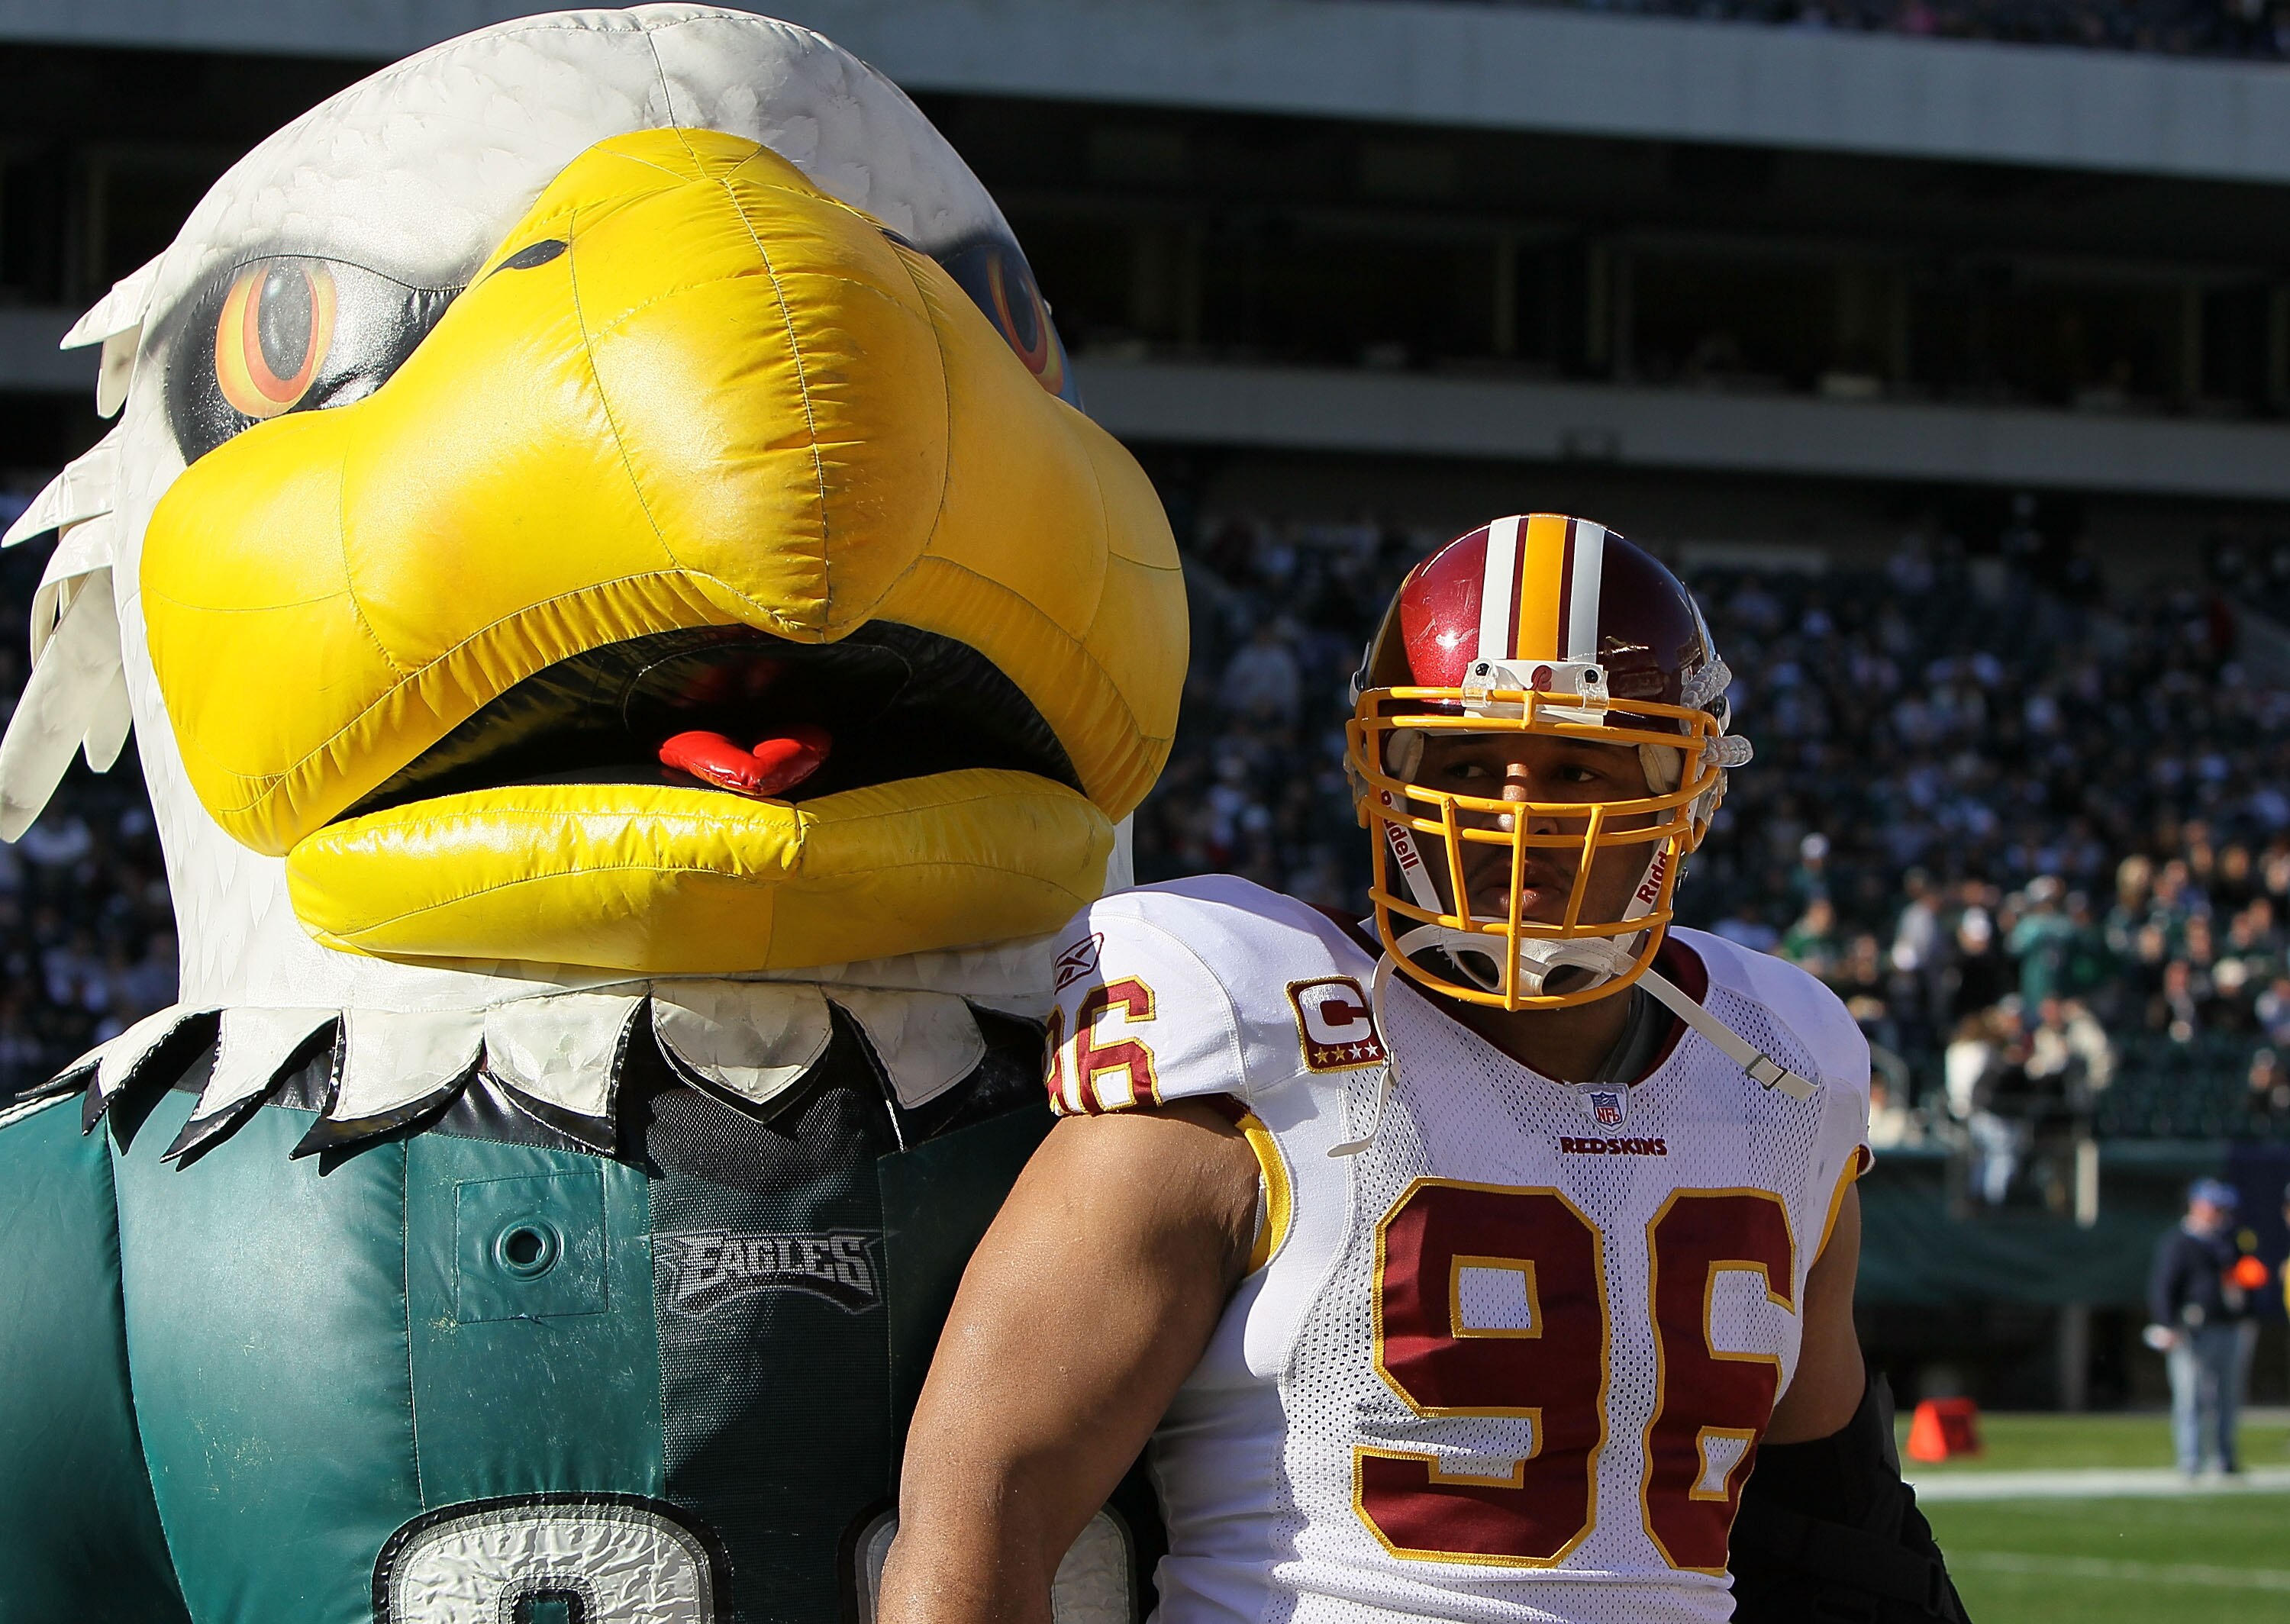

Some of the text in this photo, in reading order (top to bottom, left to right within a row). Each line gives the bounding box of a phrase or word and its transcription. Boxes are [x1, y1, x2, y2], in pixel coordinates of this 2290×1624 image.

[1381, 790, 1420, 871] Rdell
[1637, 842, 1669, 905] Ridd
[1298, 983, 1372, 1045] C
[1559, 1136, 1668, 1156] REDSKINS
[1595, 1107, 1621, 1124] NFL
[669, 1233, 876, 1303] EAGLES
[1351, 1176, 1795, 1577] 96
